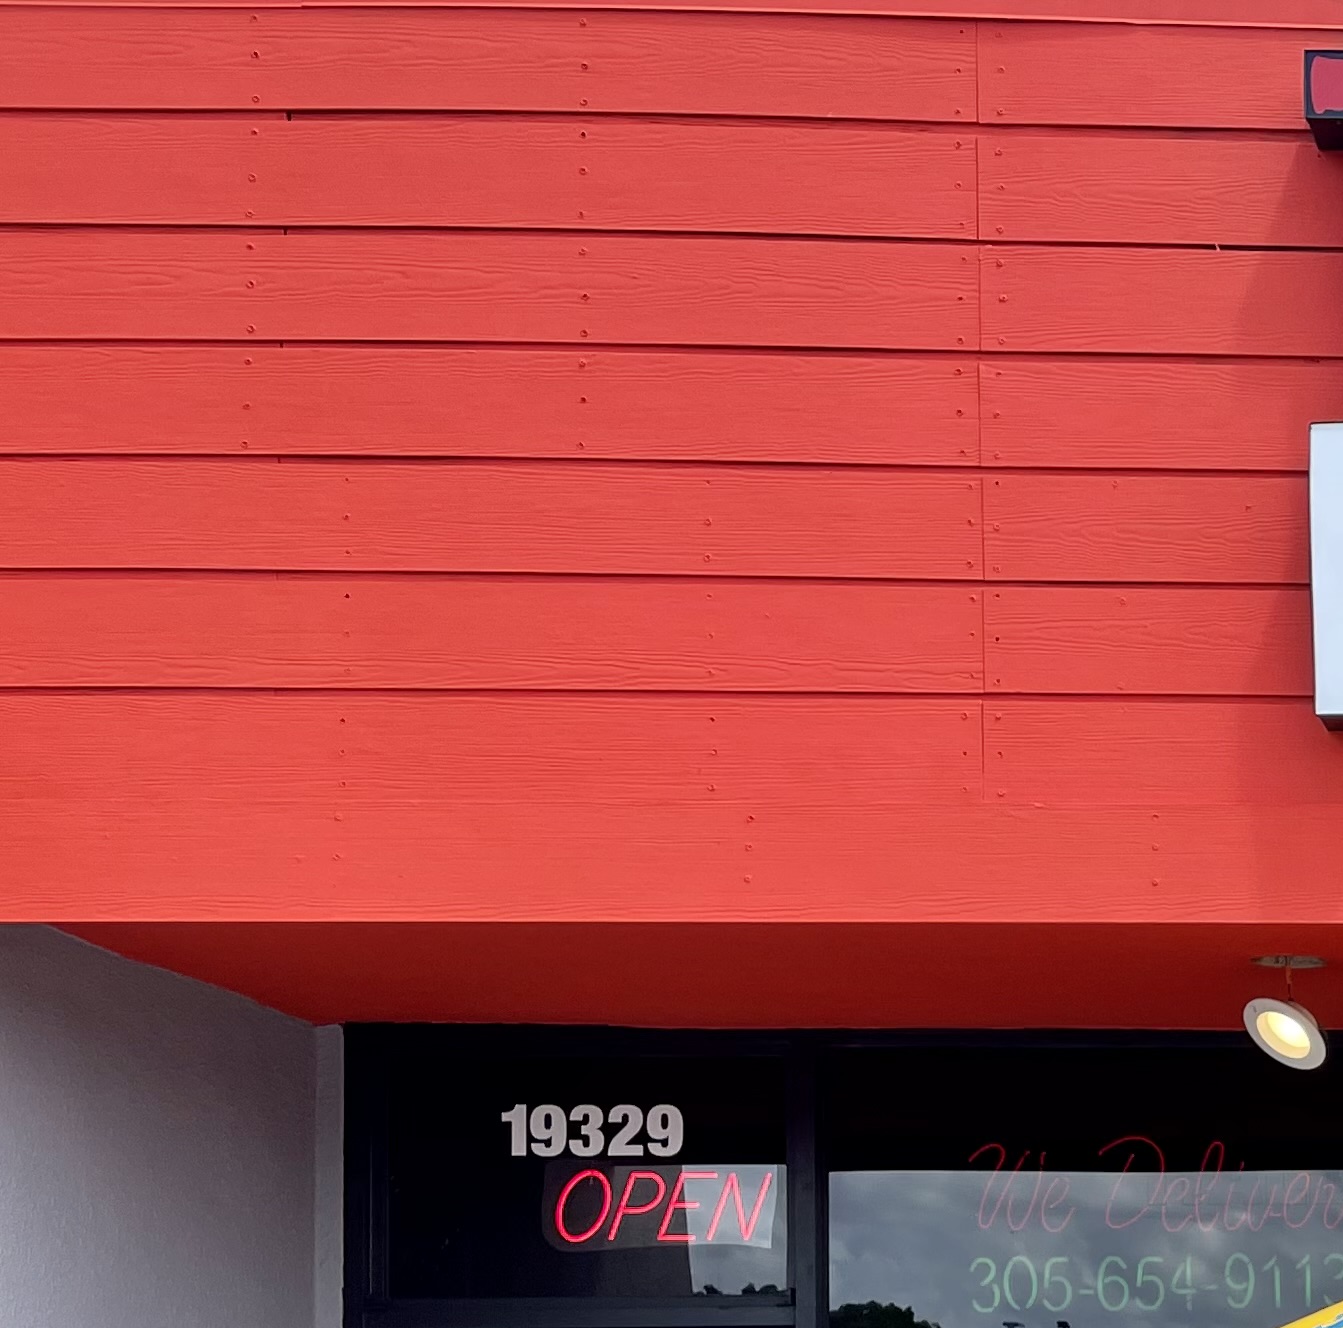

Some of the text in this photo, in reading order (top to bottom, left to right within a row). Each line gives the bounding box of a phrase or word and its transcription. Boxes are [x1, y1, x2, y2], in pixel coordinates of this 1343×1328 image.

[501, 1104, 684, 1157] 19329
[555, 1169, 772, 1243] OPEN
[969, 1143, 1076, 1232] We
